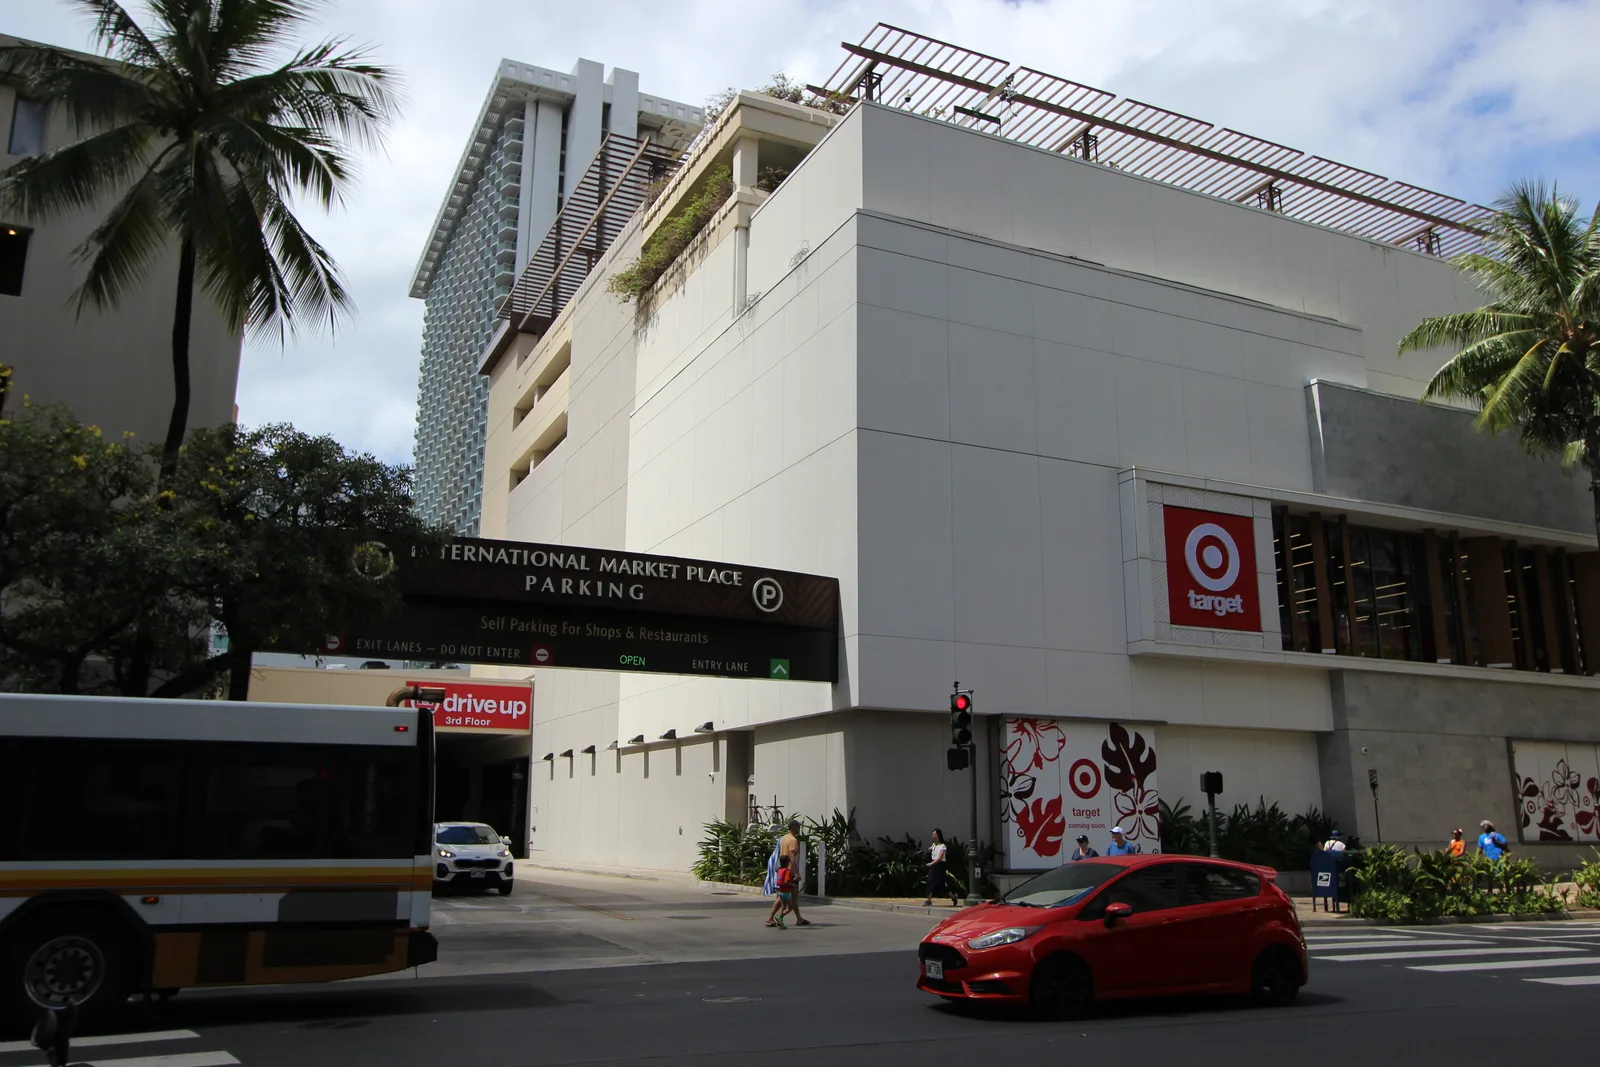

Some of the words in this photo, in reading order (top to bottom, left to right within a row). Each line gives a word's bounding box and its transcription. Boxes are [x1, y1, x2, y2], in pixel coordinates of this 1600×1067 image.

[599, 556, 680, 580] MARKET
[686, 565, 742, 587] PLACE
[525, 575, 644, 600] PARKING
[1187, 590, 1244, 616] target
[481, 615, 506, 630] Self
[510, 617, 557, 637] Parking
[562, 621, 581, 636] For
[585, 623, 622, 641] Shops
[625, 625, 635, 639] &
[639, 626, 709, 645] Restaurants
[356, 638, 383, 650] EXIT
[387, 640, 422, 653] LANES
[440, 643, 456, 655] DO
[460, 645, 483, 657] NOT
[487, 647, 521, 659] ENTER
[619, 655, 646, 666] OPEN
[692, 659, 722, 671] ENTRY
[725, 661, 749, 672] LANE
[443, 693, 497, 714] drive
[500, 699, 527, 719] up
[445, 716, 462, 725] 3rd
[465, 717, 491, 726] Floor
[1072, 807, 1101, 819] target
[1068, 822, 1090, 830] coming
